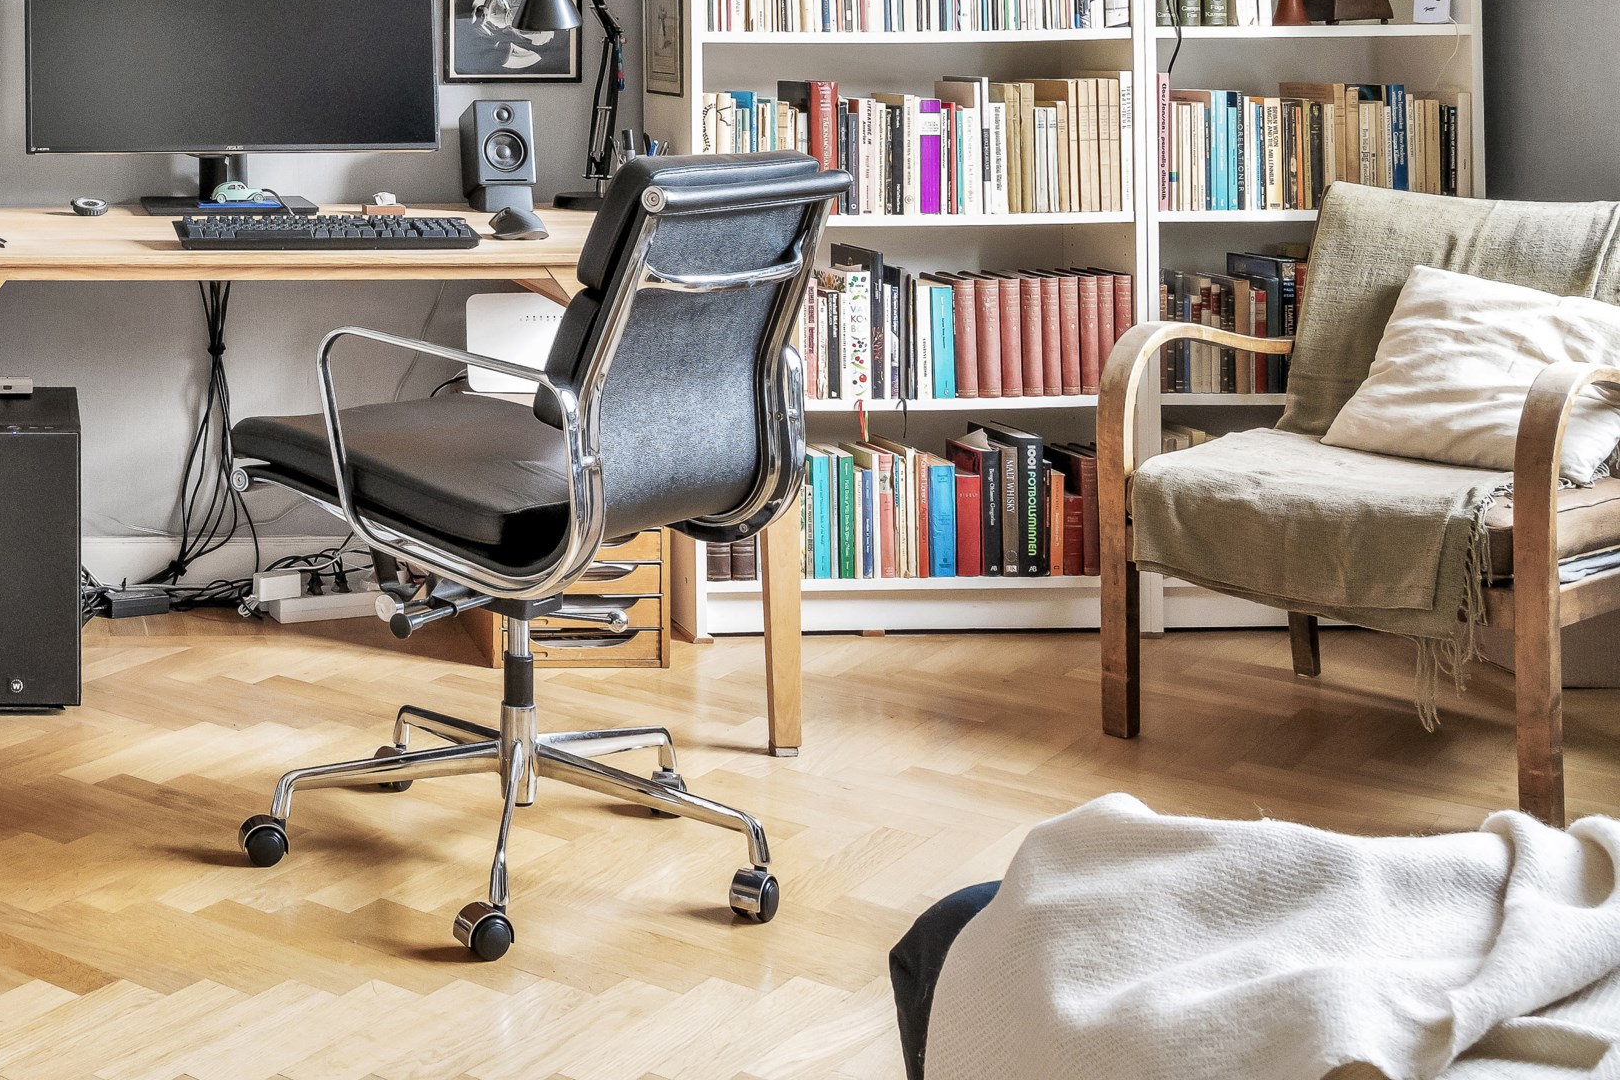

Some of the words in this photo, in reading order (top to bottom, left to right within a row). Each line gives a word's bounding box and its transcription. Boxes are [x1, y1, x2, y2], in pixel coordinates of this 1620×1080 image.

[1006, 459, 1015, 480] MALT
[1027, 445, 1037, 470] 1001
[1006, 482, 1015, 513] WHISKY
[1027, 471, 1037, 556] FOTBOLLSMINNEN
